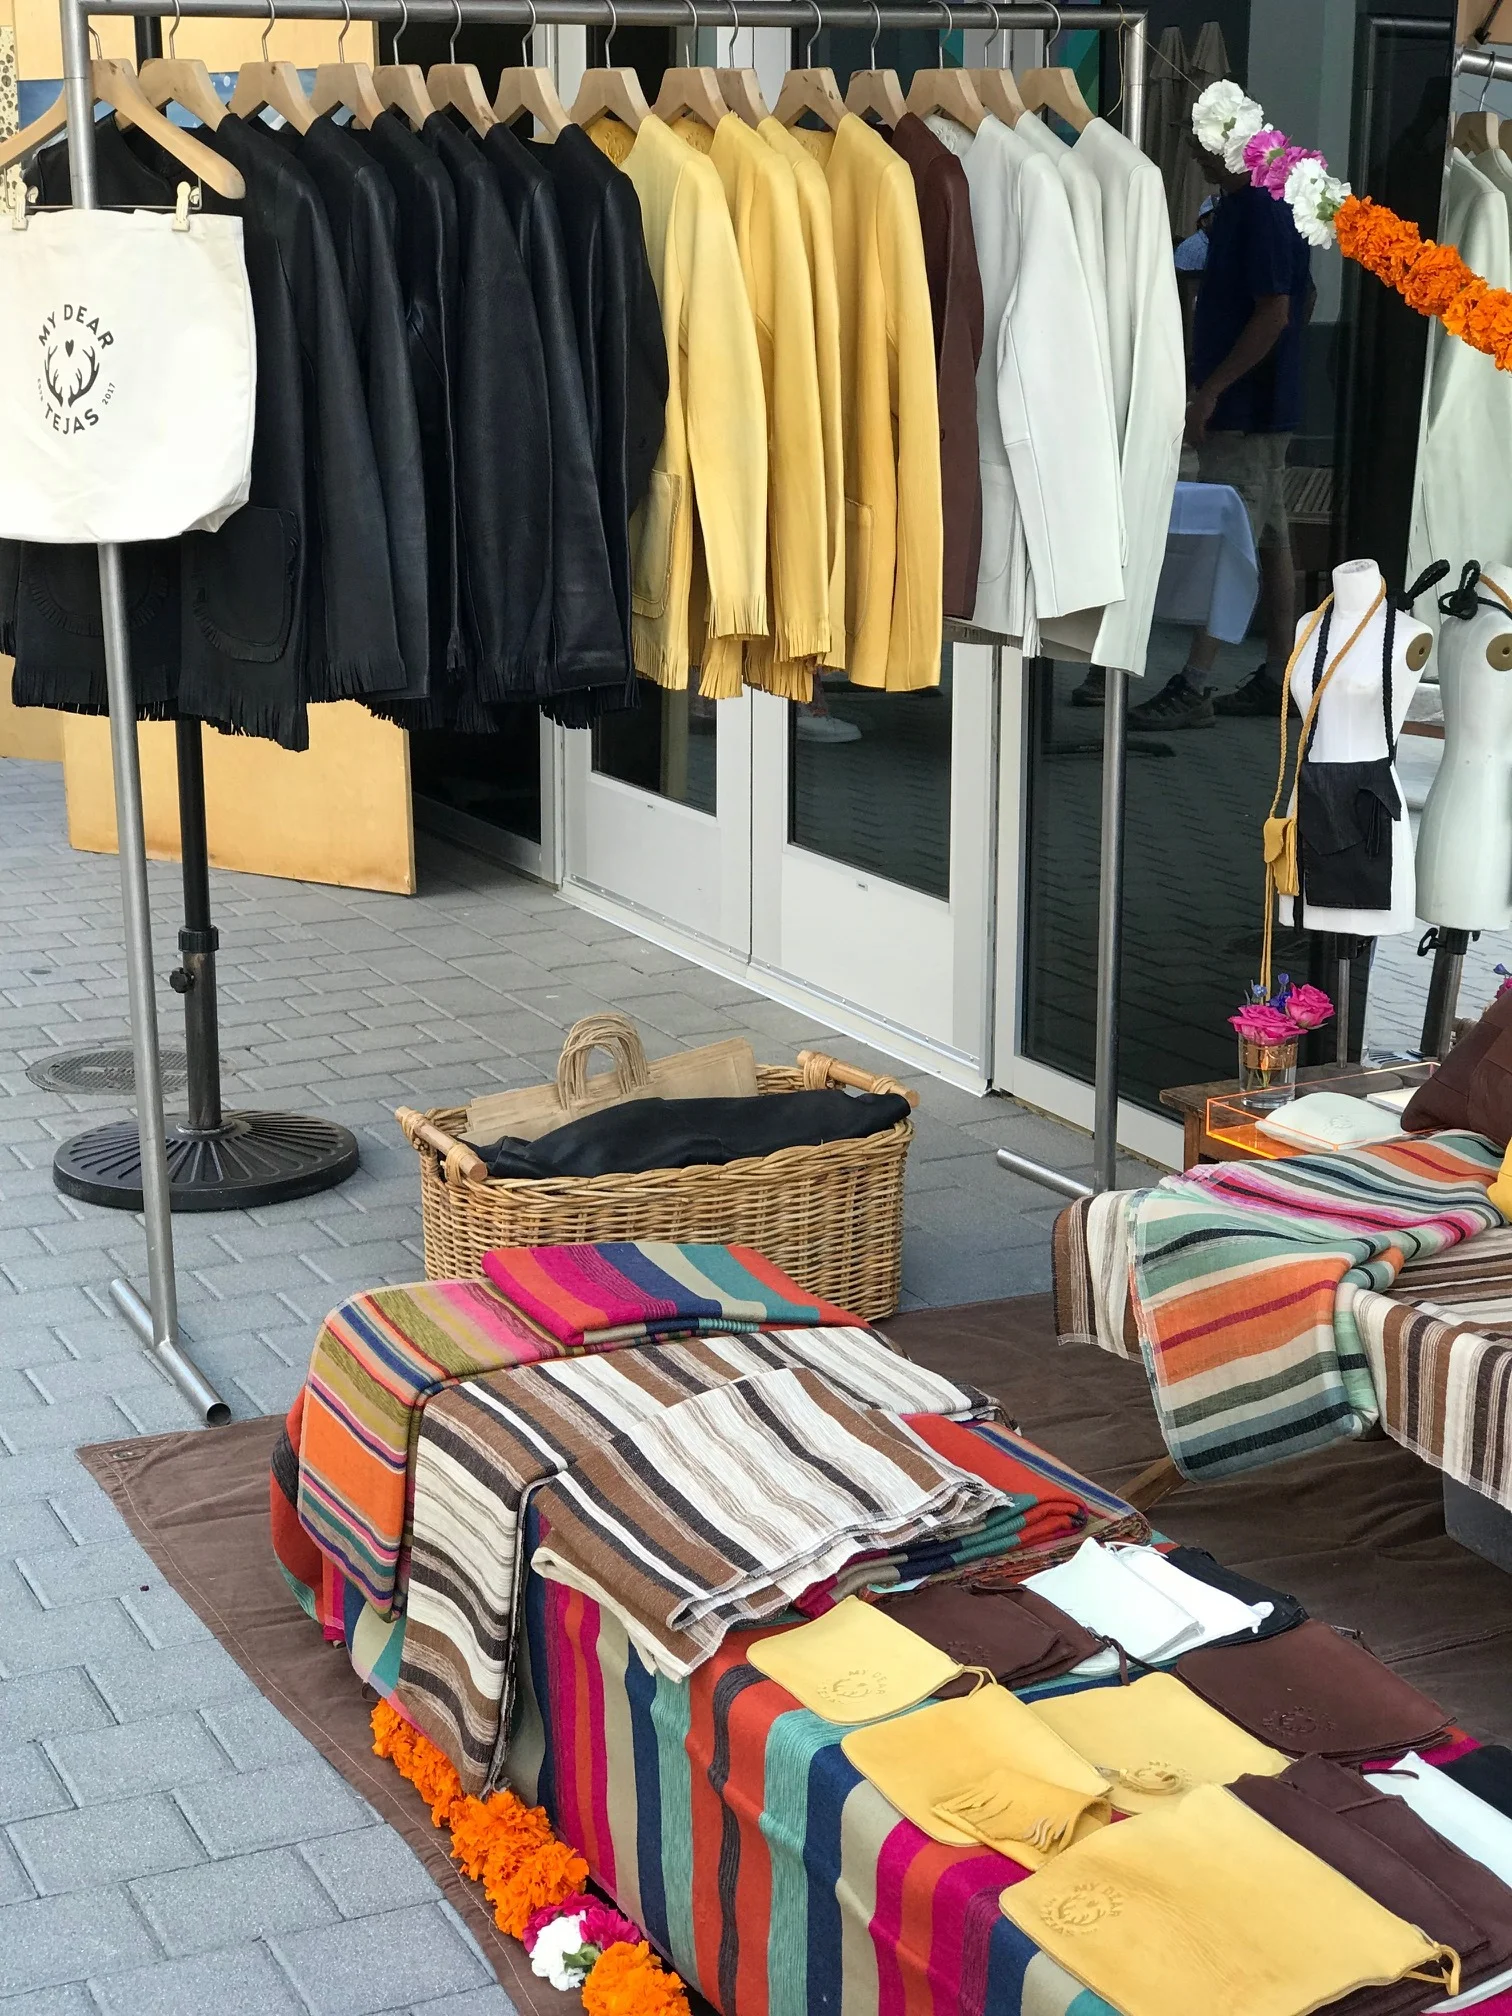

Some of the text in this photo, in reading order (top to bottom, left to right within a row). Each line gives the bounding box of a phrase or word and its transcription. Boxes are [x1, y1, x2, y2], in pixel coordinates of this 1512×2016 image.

[38, 304, 114, 349] MY DEAR
[101, 382, 115, 405] 2017
[45, 402, 99, 435] TEJAS
